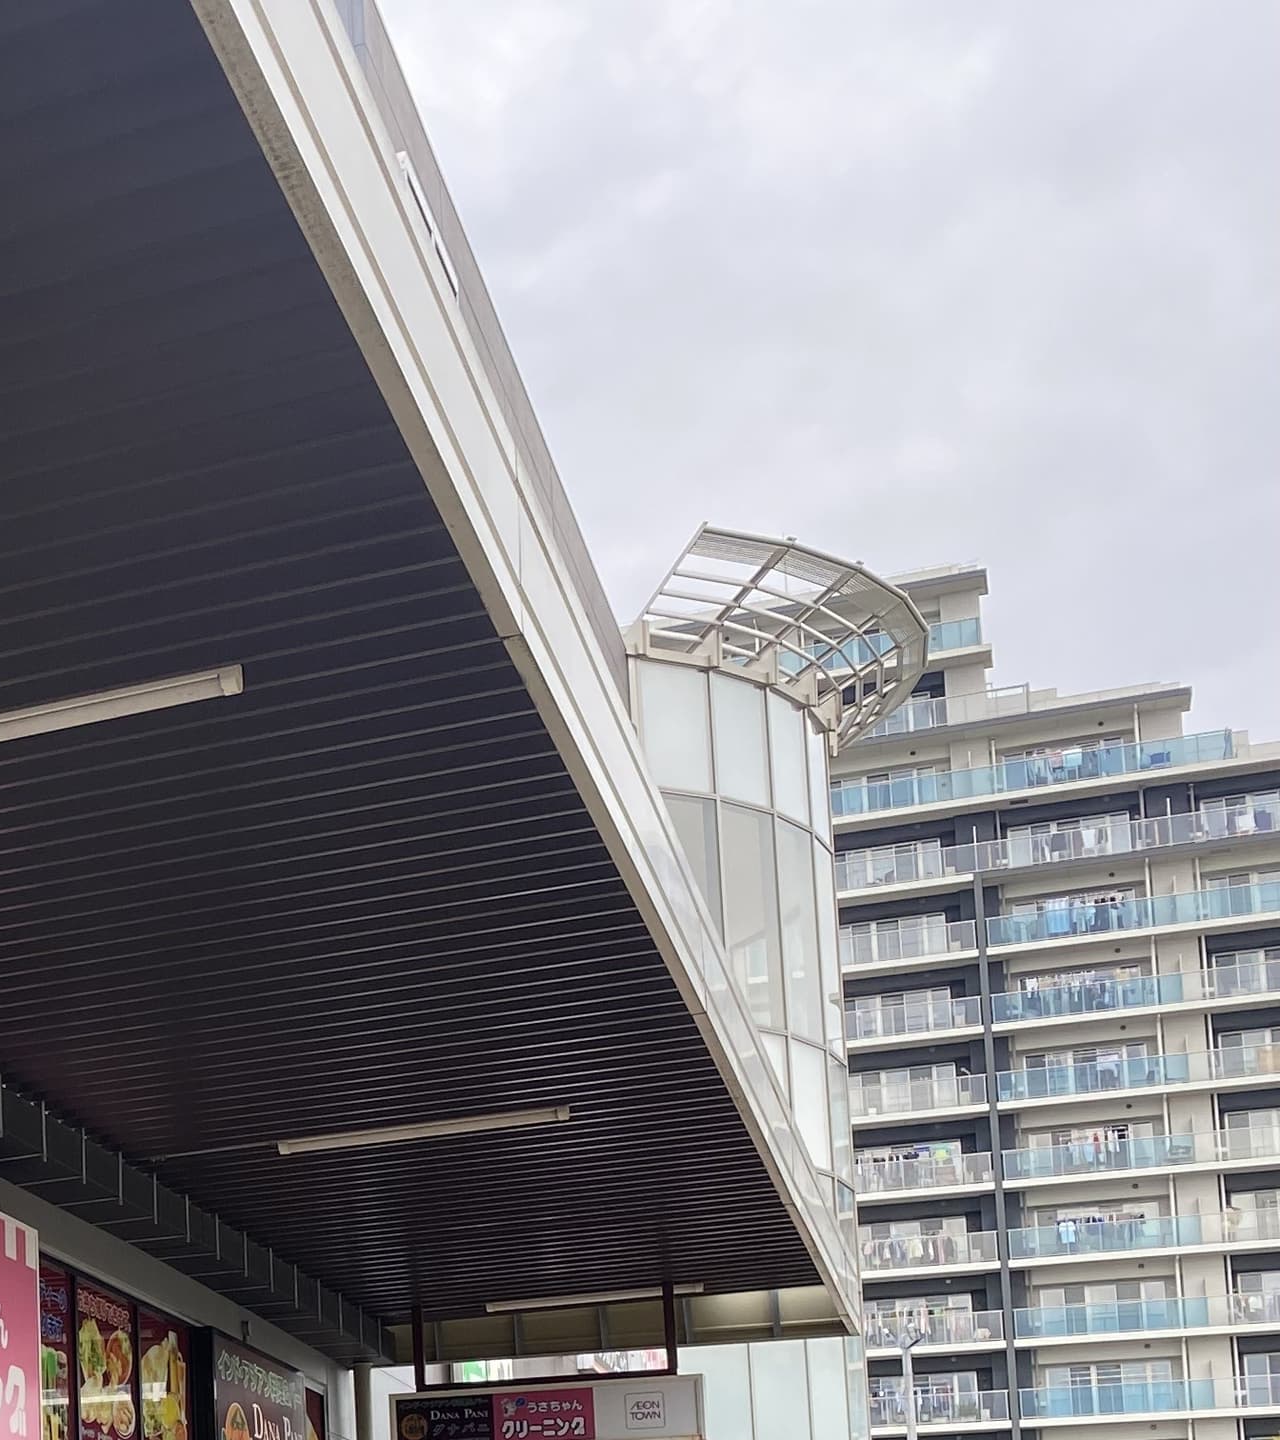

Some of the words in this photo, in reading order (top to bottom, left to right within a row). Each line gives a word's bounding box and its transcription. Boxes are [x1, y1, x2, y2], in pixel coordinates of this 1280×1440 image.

[527, 1400, 583, 1413] うさちゃん
[629, 1411, 661, 1421] TOWN
[502, 1417, 585, 1439] クリーニング
